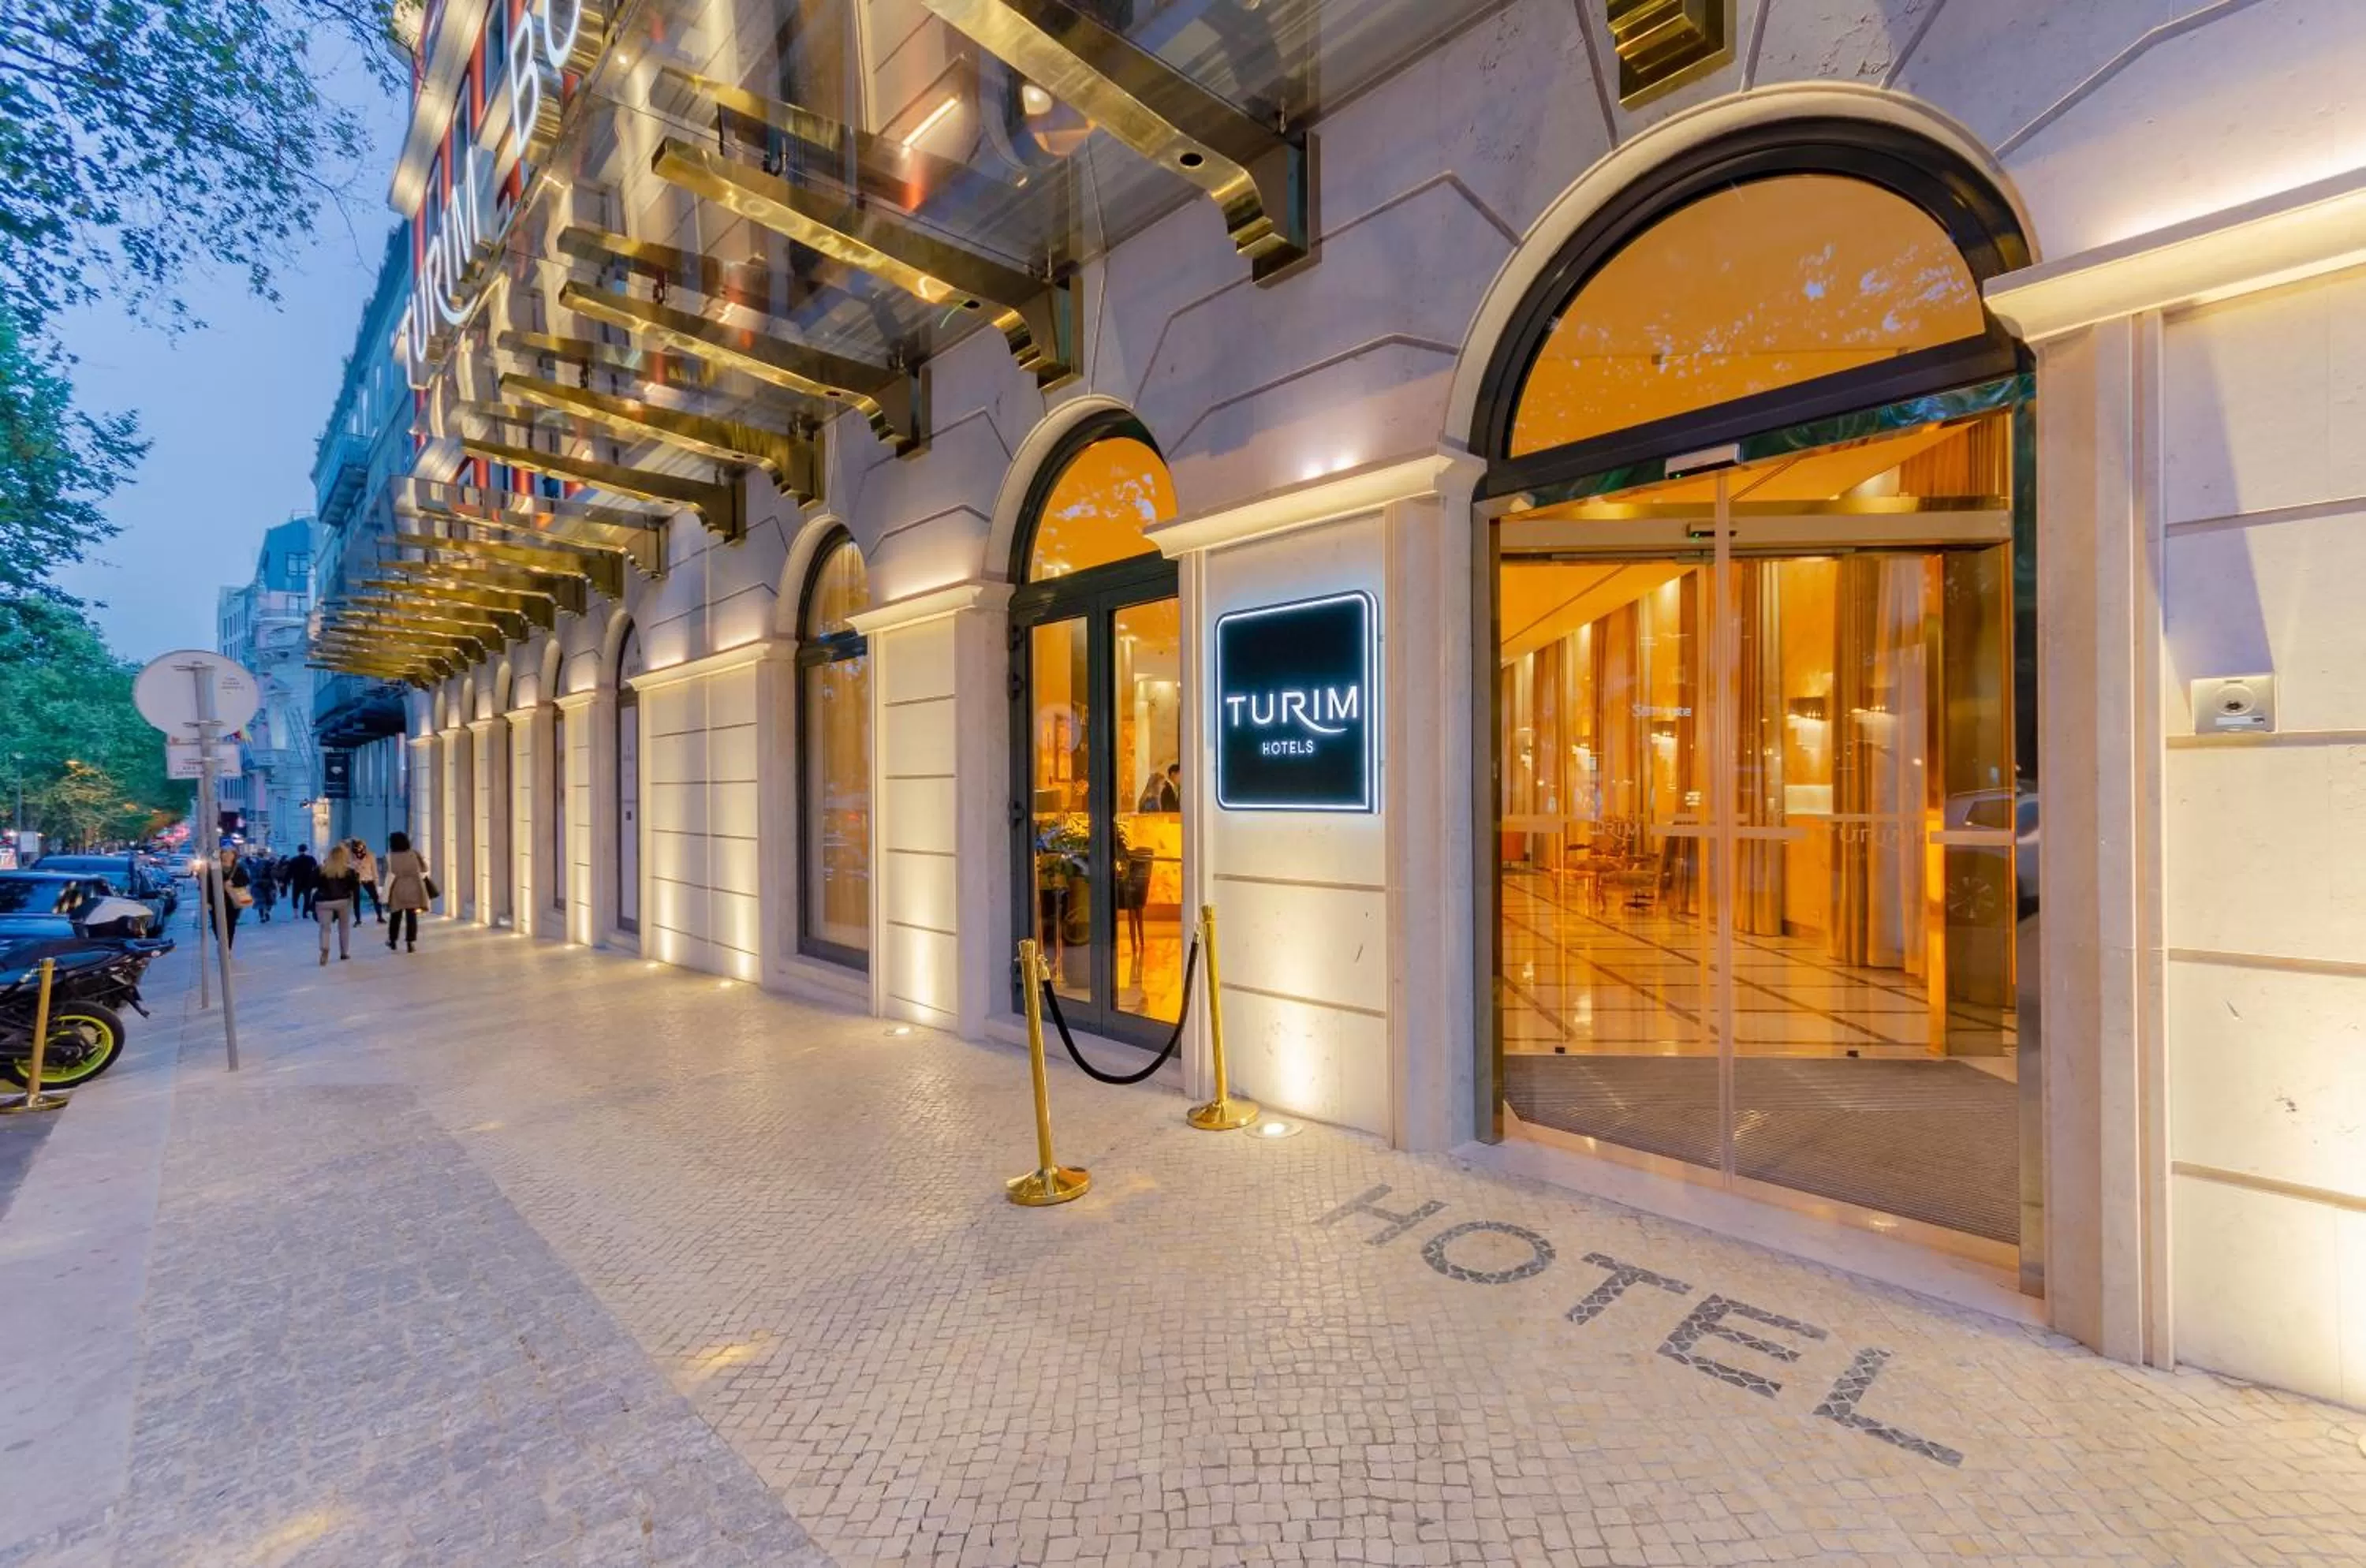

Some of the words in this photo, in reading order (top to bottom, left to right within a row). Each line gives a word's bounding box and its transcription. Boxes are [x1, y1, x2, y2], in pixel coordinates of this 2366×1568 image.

[1226, 685, 1358, 734] TURIM
[1261, 739, 1314, 755] HOTELS
[1311, 1182, 1965, 1468] HOTEL
